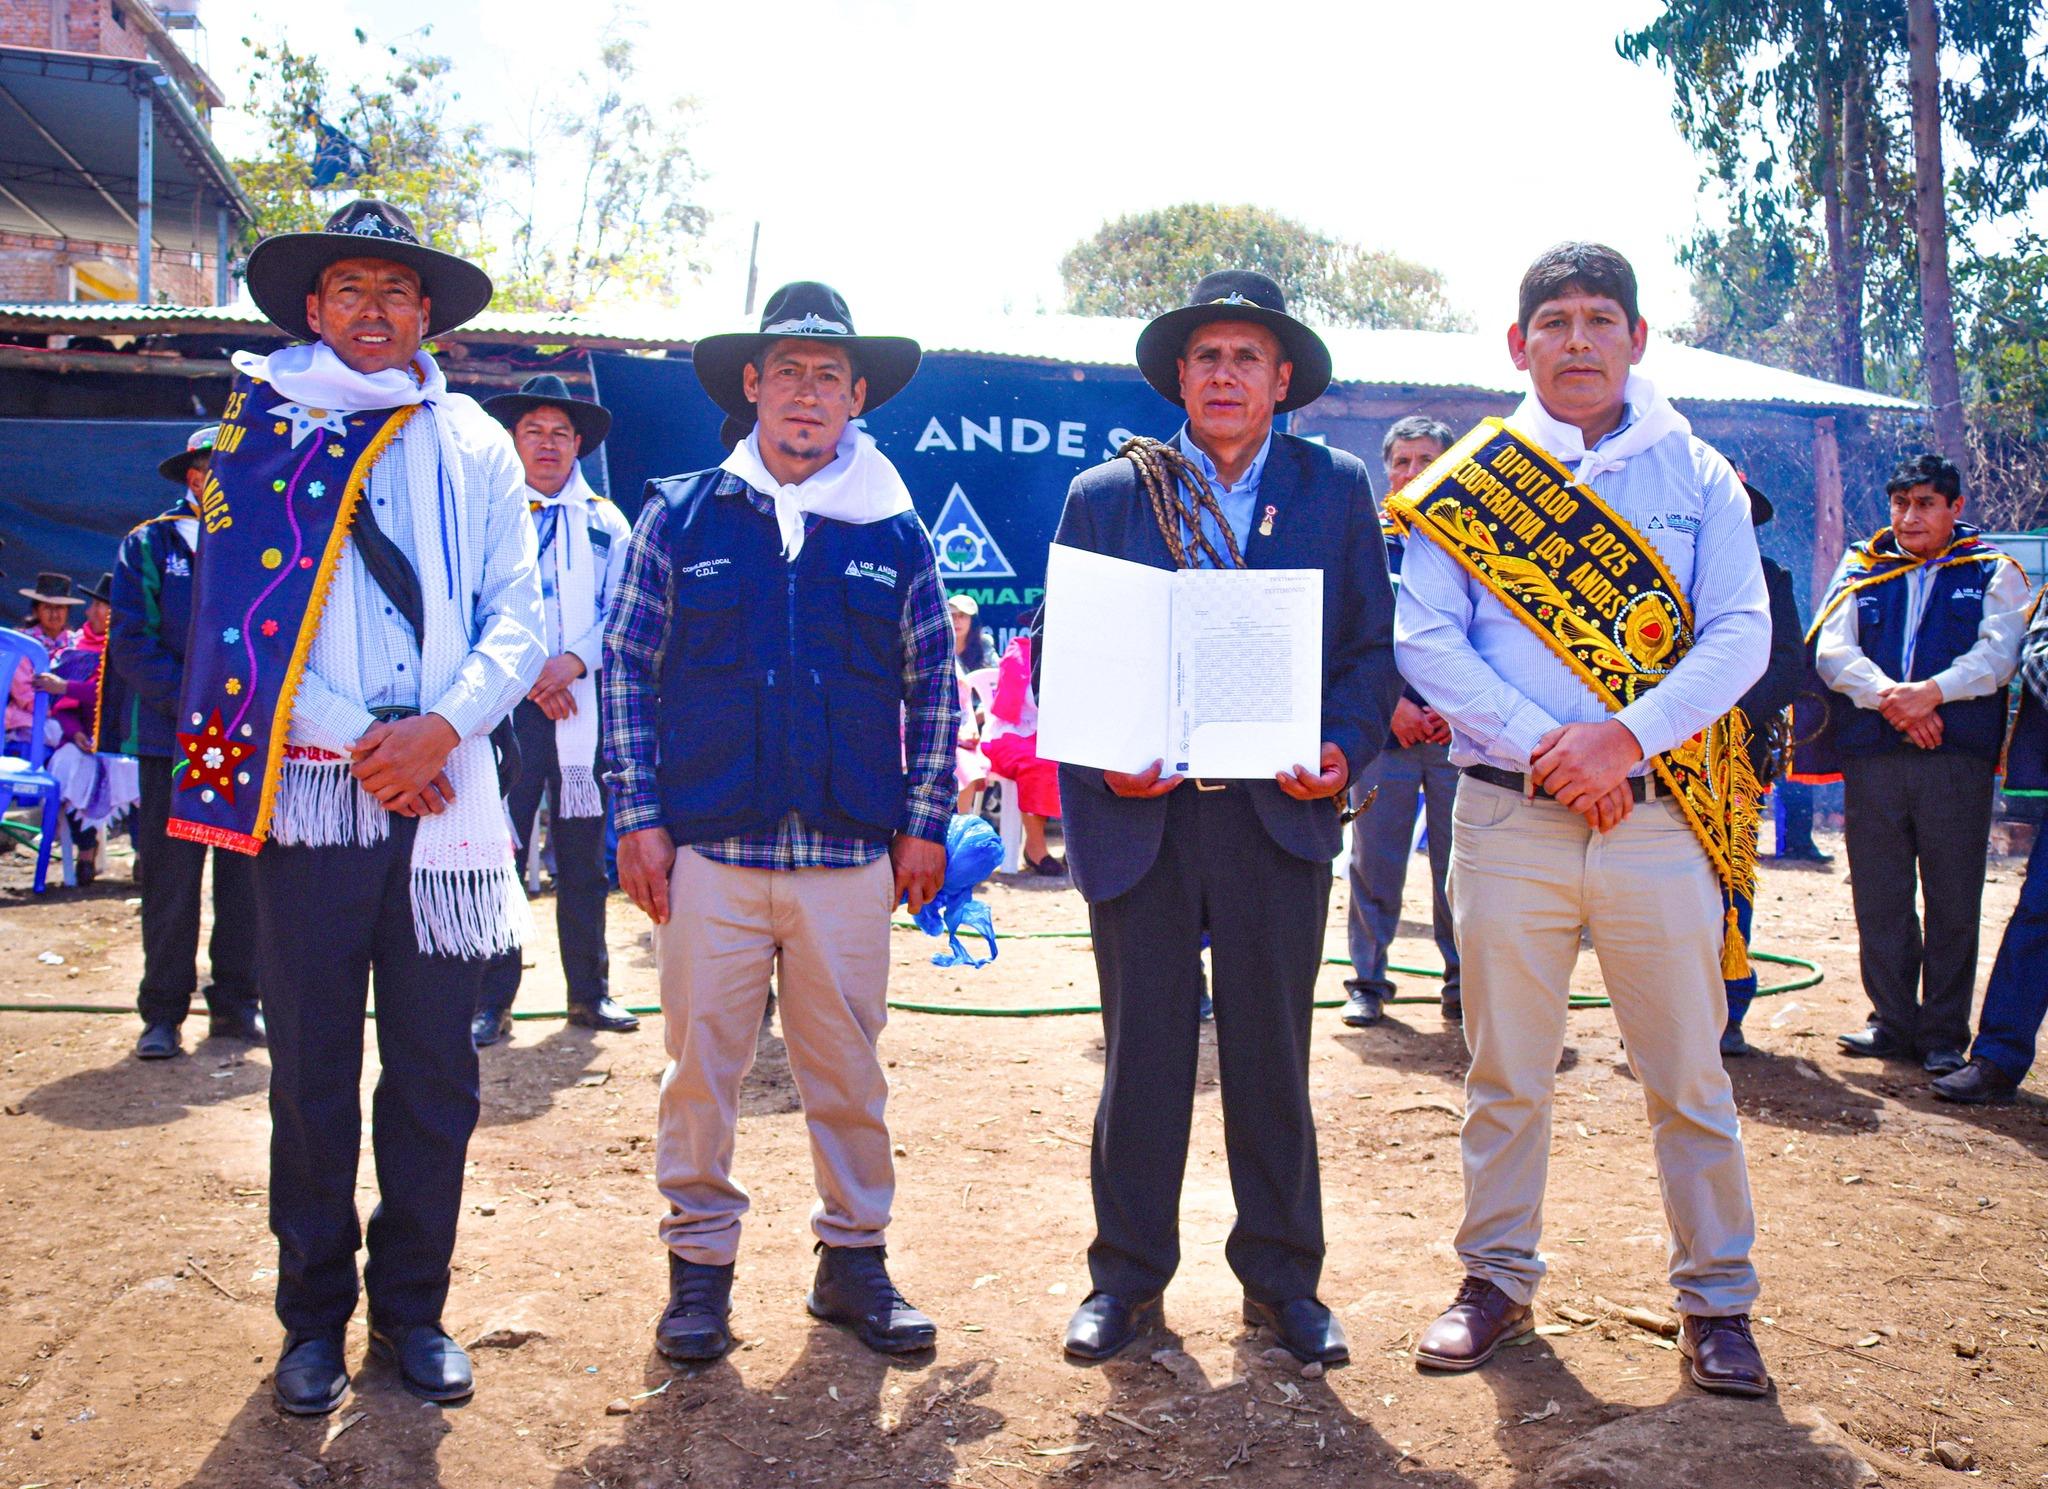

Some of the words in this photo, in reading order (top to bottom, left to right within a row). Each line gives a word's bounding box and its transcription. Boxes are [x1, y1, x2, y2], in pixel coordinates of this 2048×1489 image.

[1451, 457, 1546, 544] COOPERATIVA
[1535, 531, 1575, 568] LOS
[1566, 561, 1628, 620] ANDES
[1490, 445, 1579, 523] DIPUTADO
[1579, 523, 1638, 577] 2025
[711, 558, 731, 566] LOCAL
[860, 561, 874, 570] LOS
